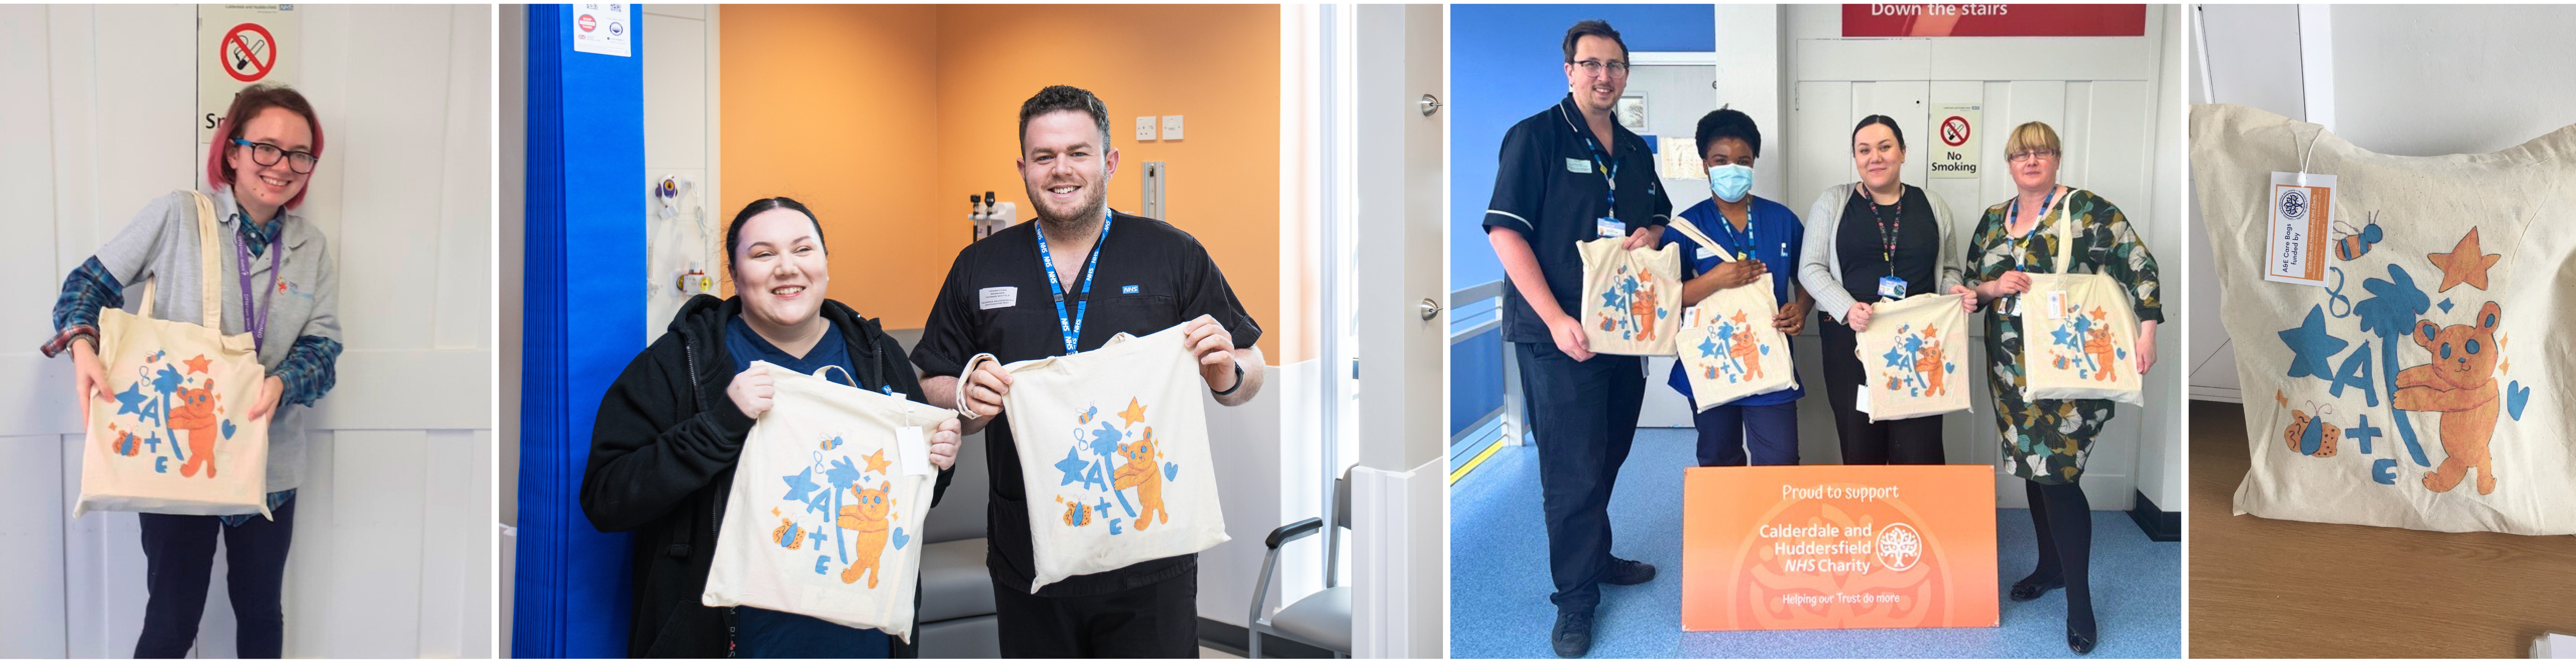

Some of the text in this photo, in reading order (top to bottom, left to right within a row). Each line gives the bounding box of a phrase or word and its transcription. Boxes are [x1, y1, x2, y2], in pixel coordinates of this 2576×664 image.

[1872, 4, 2008, 16] Down the stairs
[1947, 151, 1961, 160] No
[1932, 162, 1976, 173] Smoking
[2298, 190, 2307, 200] Difference
[2293, 233, 2301, 241] by
[1044, 256, 1052, 268] NHS
[1048, 271, 1057, 284] NHS
[1615, 296, 1627, 314] A
[1061, 318, 1070, 331] NHS
[1065, 336, 1073, 350] NHS
[2067, 334, 2080, 352] A
[1714, 342, 1727, 359] A
[1899, 354, 1912, 372] A
[2329, 339, 2379, 407] A
[139, 396, 160, 427] A
[1083, 459, 1108, 492] A
[1783, 485, 1899, 502] Proud to support
[807, 487, 830, 522] A
[1759, 523, 1872, 538] Calderdale and
[1775, 541, 1871, 555] Huddersfield
[1785, 559, 1870, 574] NHS Charity
[1783, 592, 1900, 606] Helping our Trust do more
